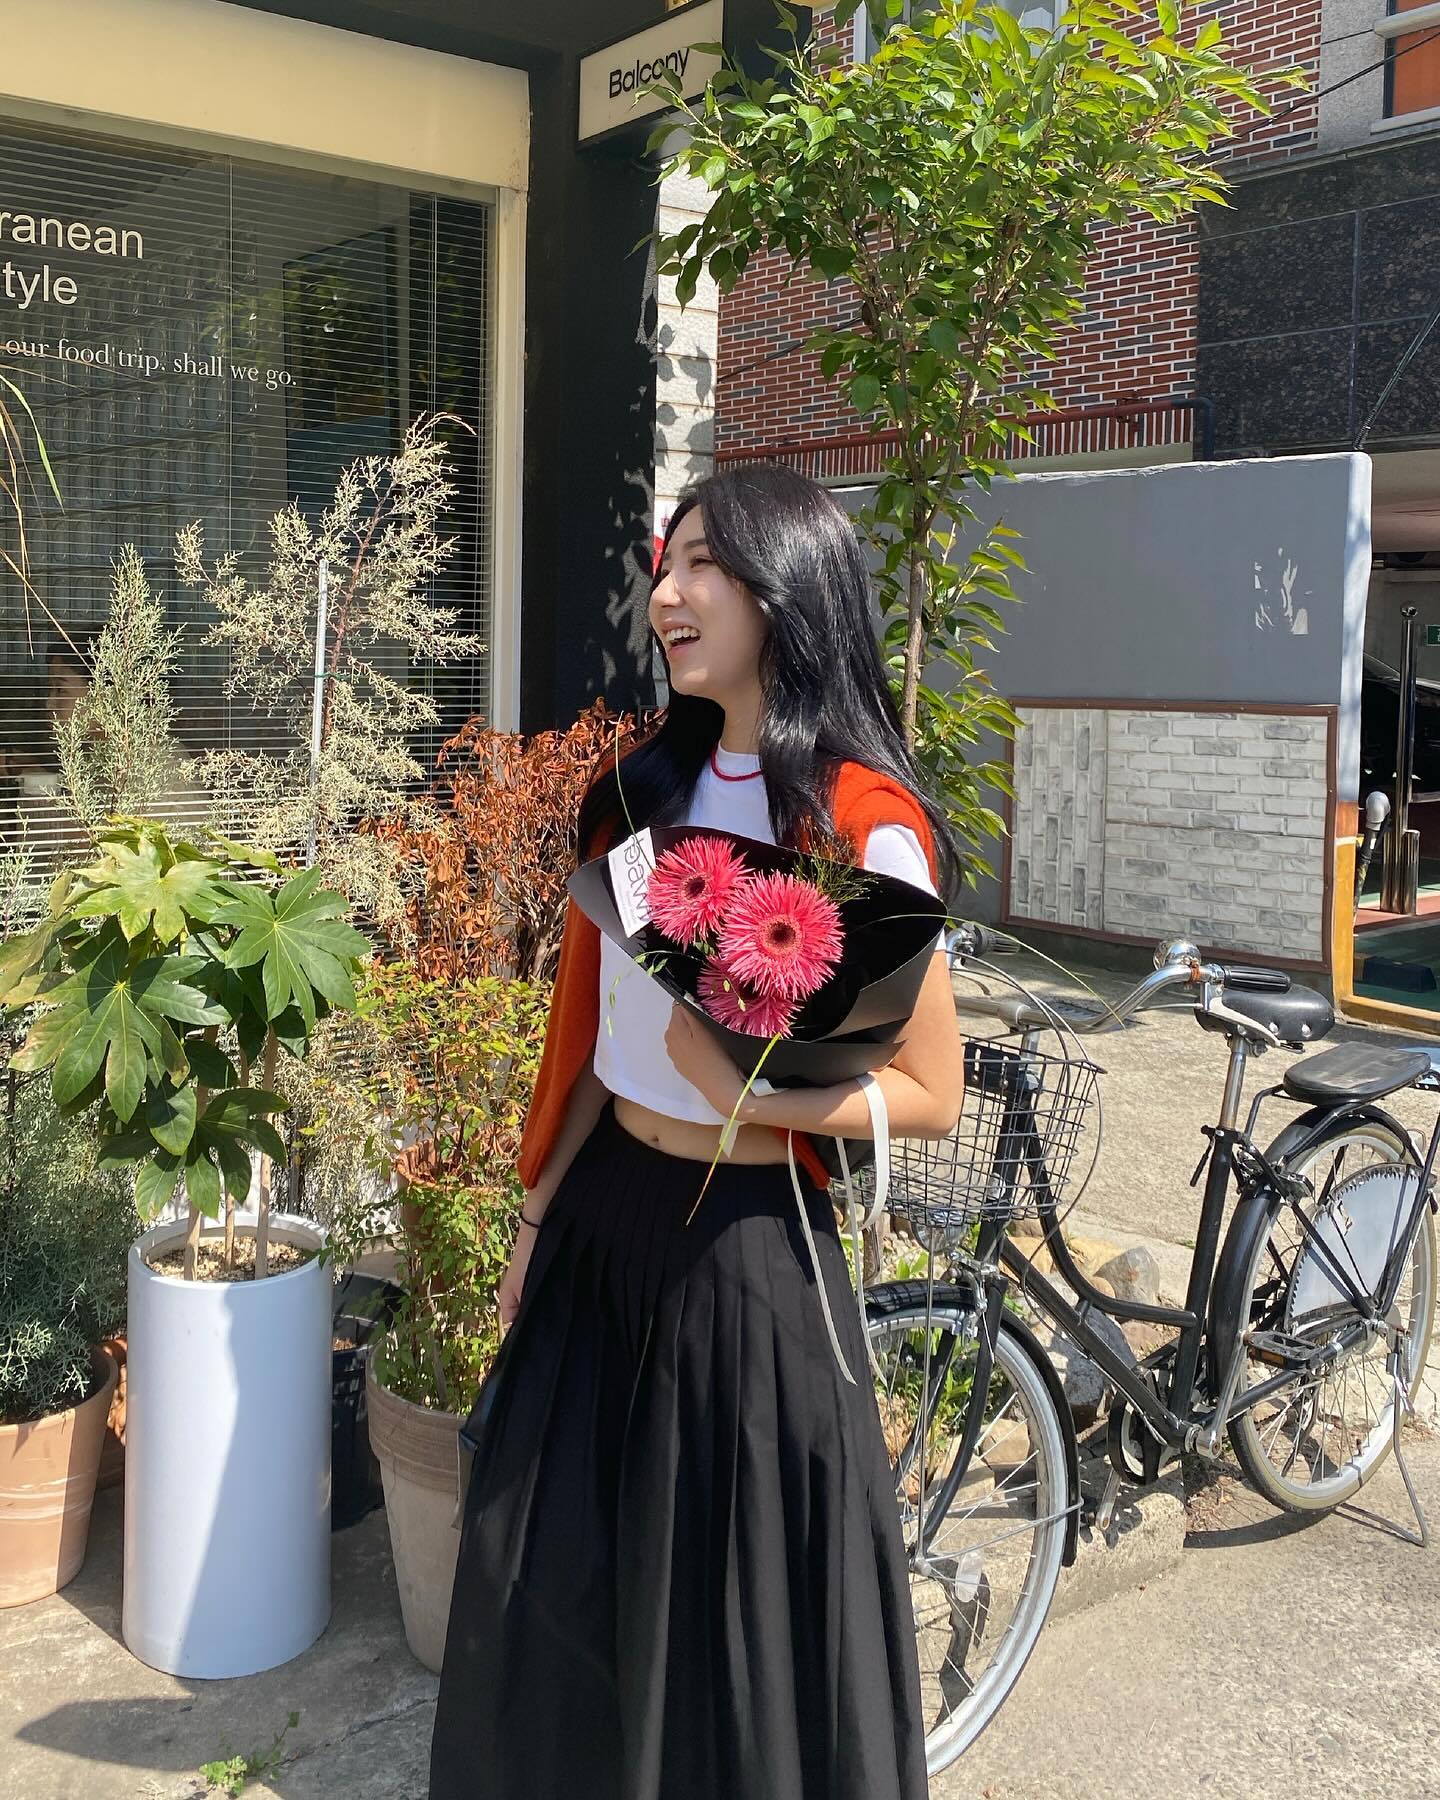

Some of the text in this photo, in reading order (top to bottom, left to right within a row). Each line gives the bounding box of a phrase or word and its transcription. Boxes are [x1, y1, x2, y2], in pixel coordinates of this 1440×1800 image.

[609, 48, 690, 99] Balcony
[2, 261, 78, 310] tyle
[5, 339, 50, 358] our
[57, 338, 111, 365] food
[173, 352, 223, 378] shall
[230, 364, 259, 382] we
[265, 368, 297, 391] go.
